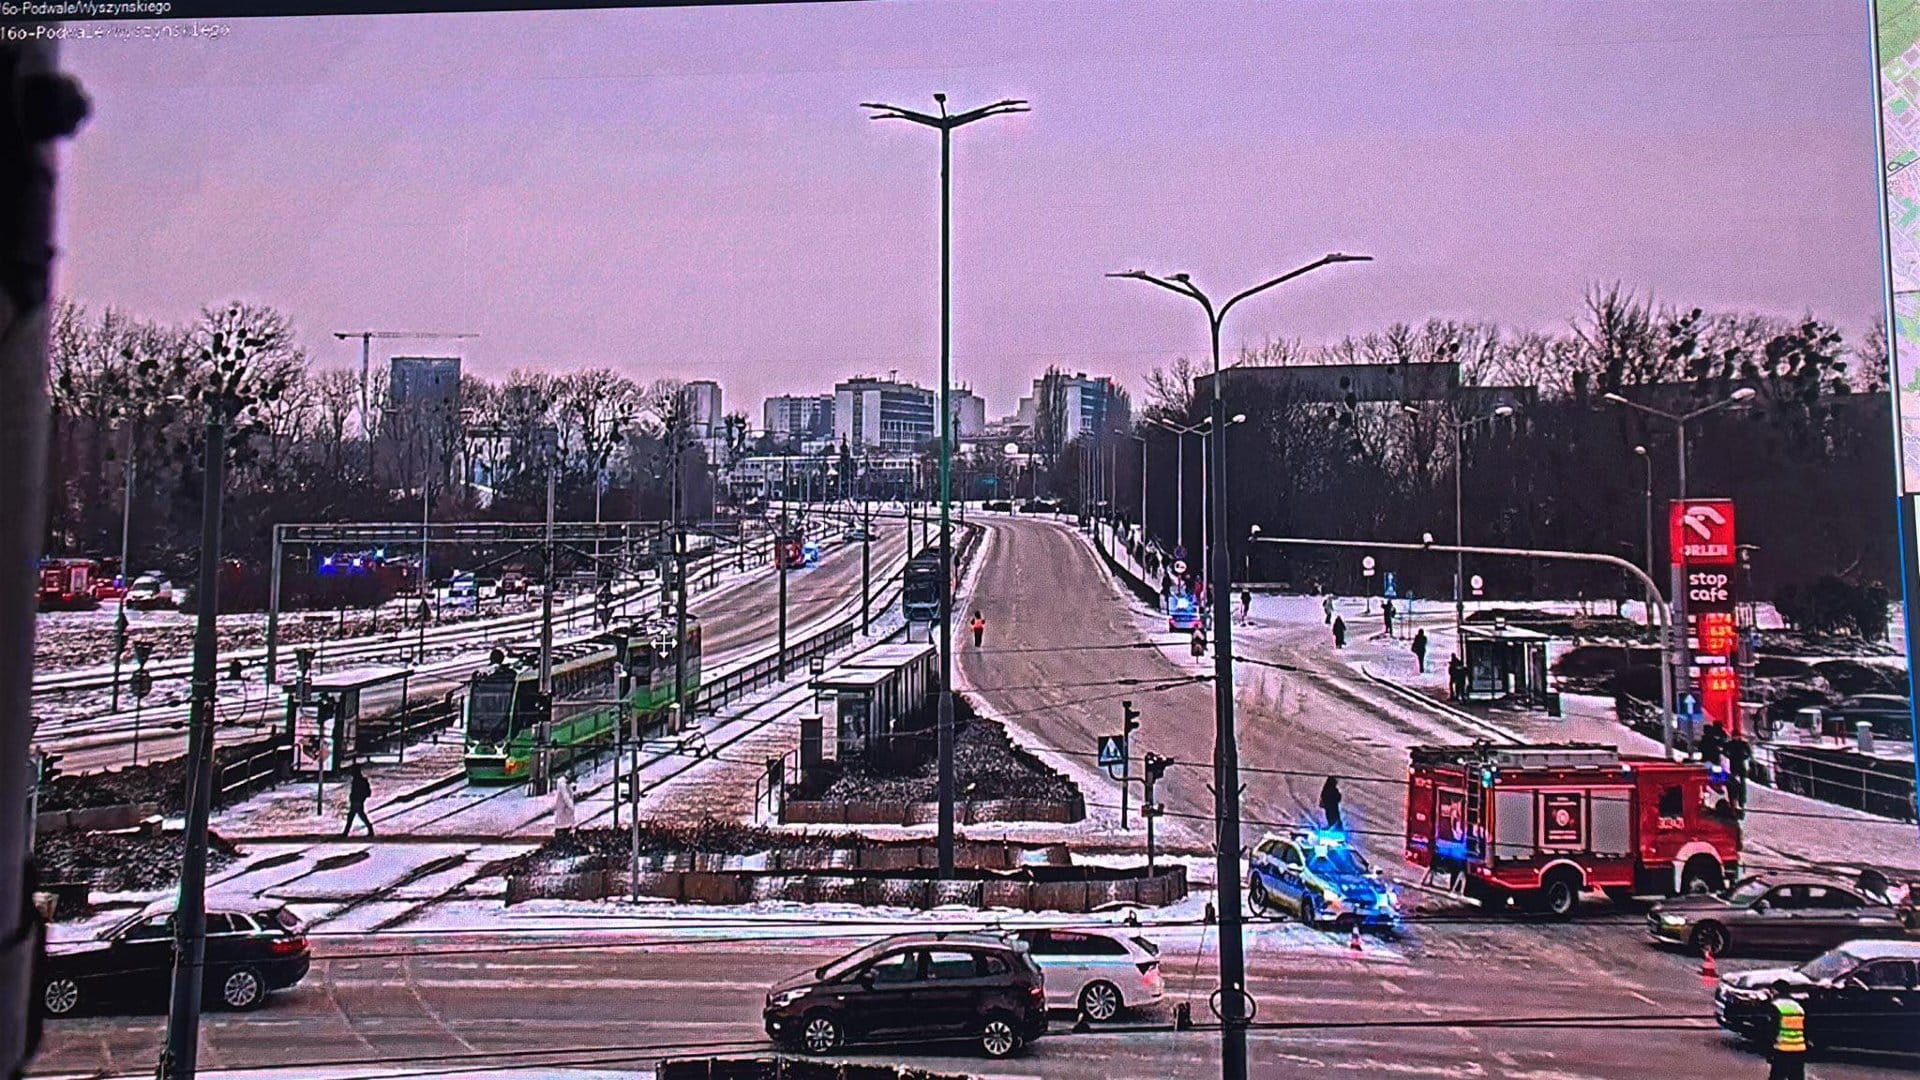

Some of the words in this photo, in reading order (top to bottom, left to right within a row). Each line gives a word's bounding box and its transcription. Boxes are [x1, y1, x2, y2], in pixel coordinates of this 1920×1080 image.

[0, 0, 172, 16] 6o-Podwale/Wyszynskiego
[1689, 572, 1728, 588] stop
[1689, 587, 1728, 602] cafe
